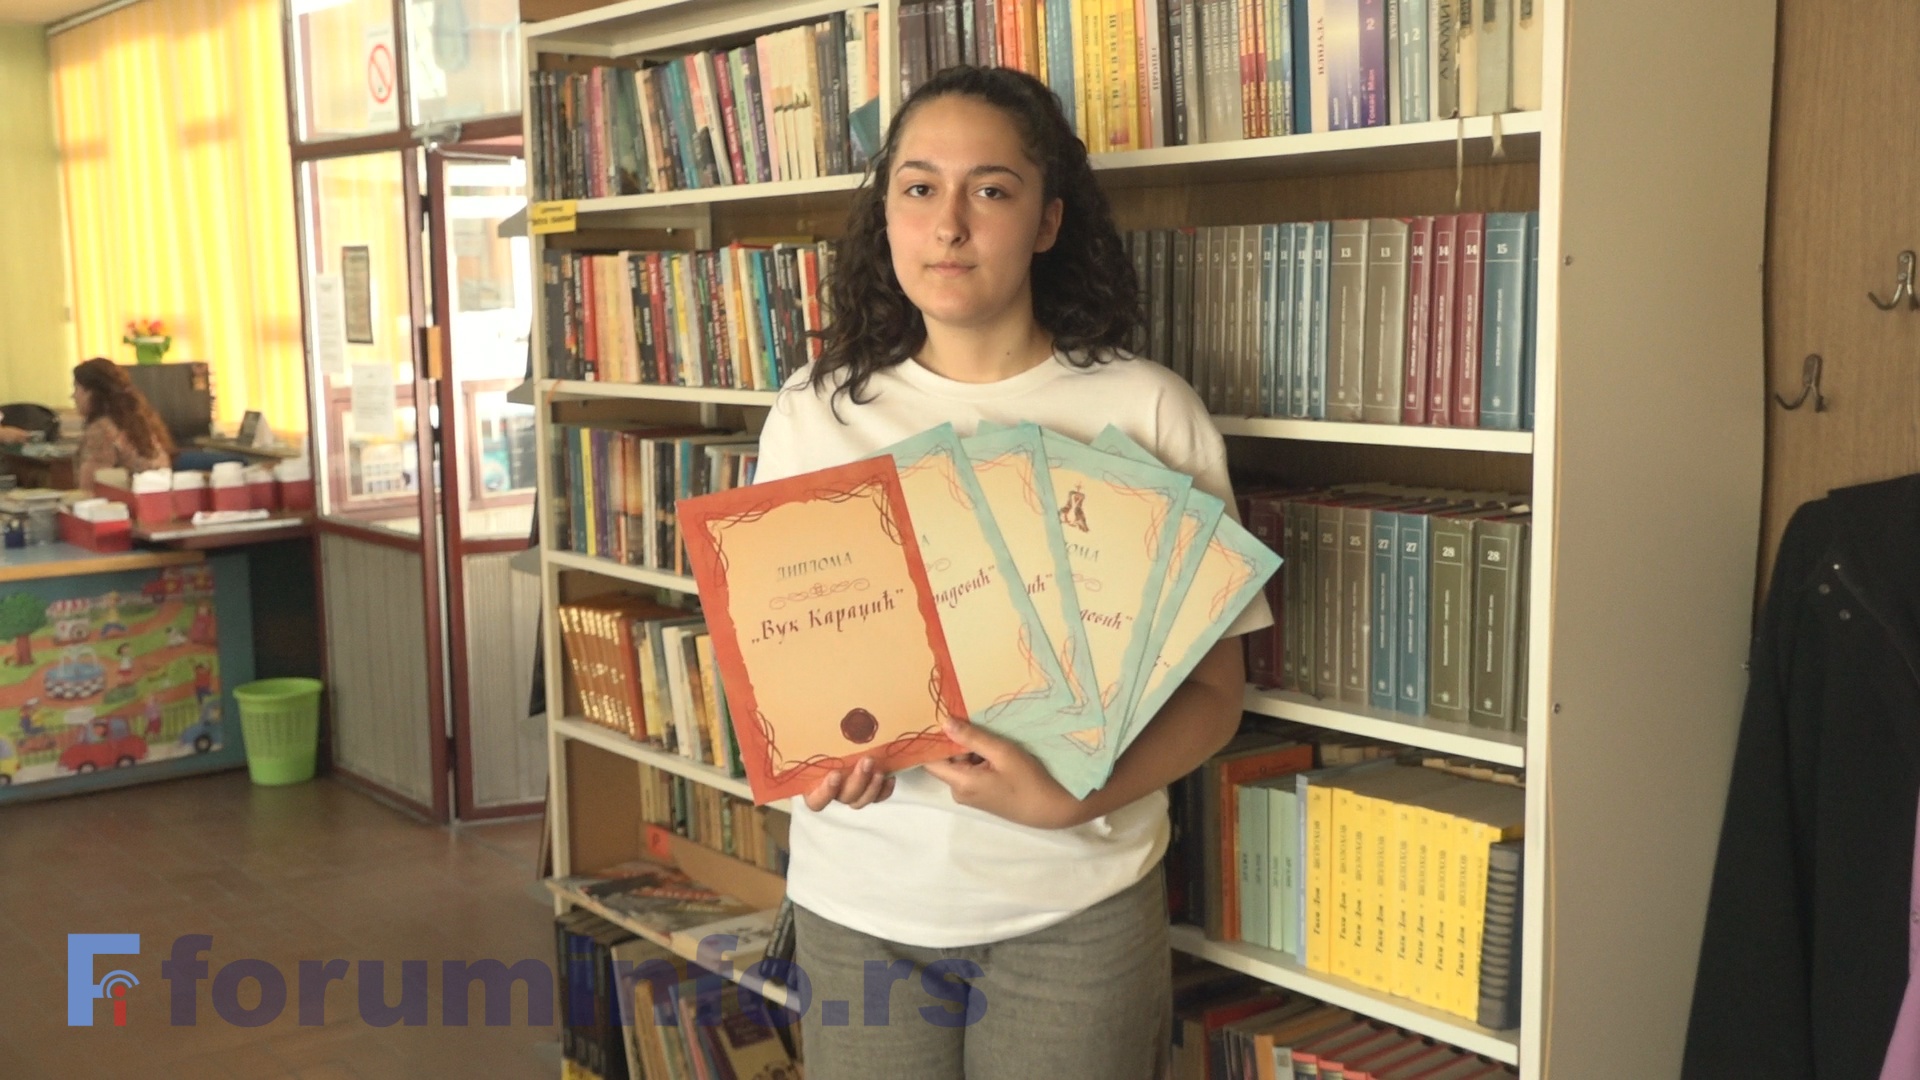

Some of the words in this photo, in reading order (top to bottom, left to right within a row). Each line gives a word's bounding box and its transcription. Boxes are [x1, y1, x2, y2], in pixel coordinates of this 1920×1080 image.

[1341, 247, 1351, 258] 13
[1380, 247, 1391, 258] 13
[1413, 245, 1423, 256] 14
[1439, 245, 1449, 256] 14
[1466, 244, 1478, 255] 14
[1497, 243, 1508, 254] 15
[1378, 539, 1389, 549] 27
[1405, 542, 1417, 553] 27
[1442, 546, 1455, 558] 28
[1487, 550, 1500, 562] 28
